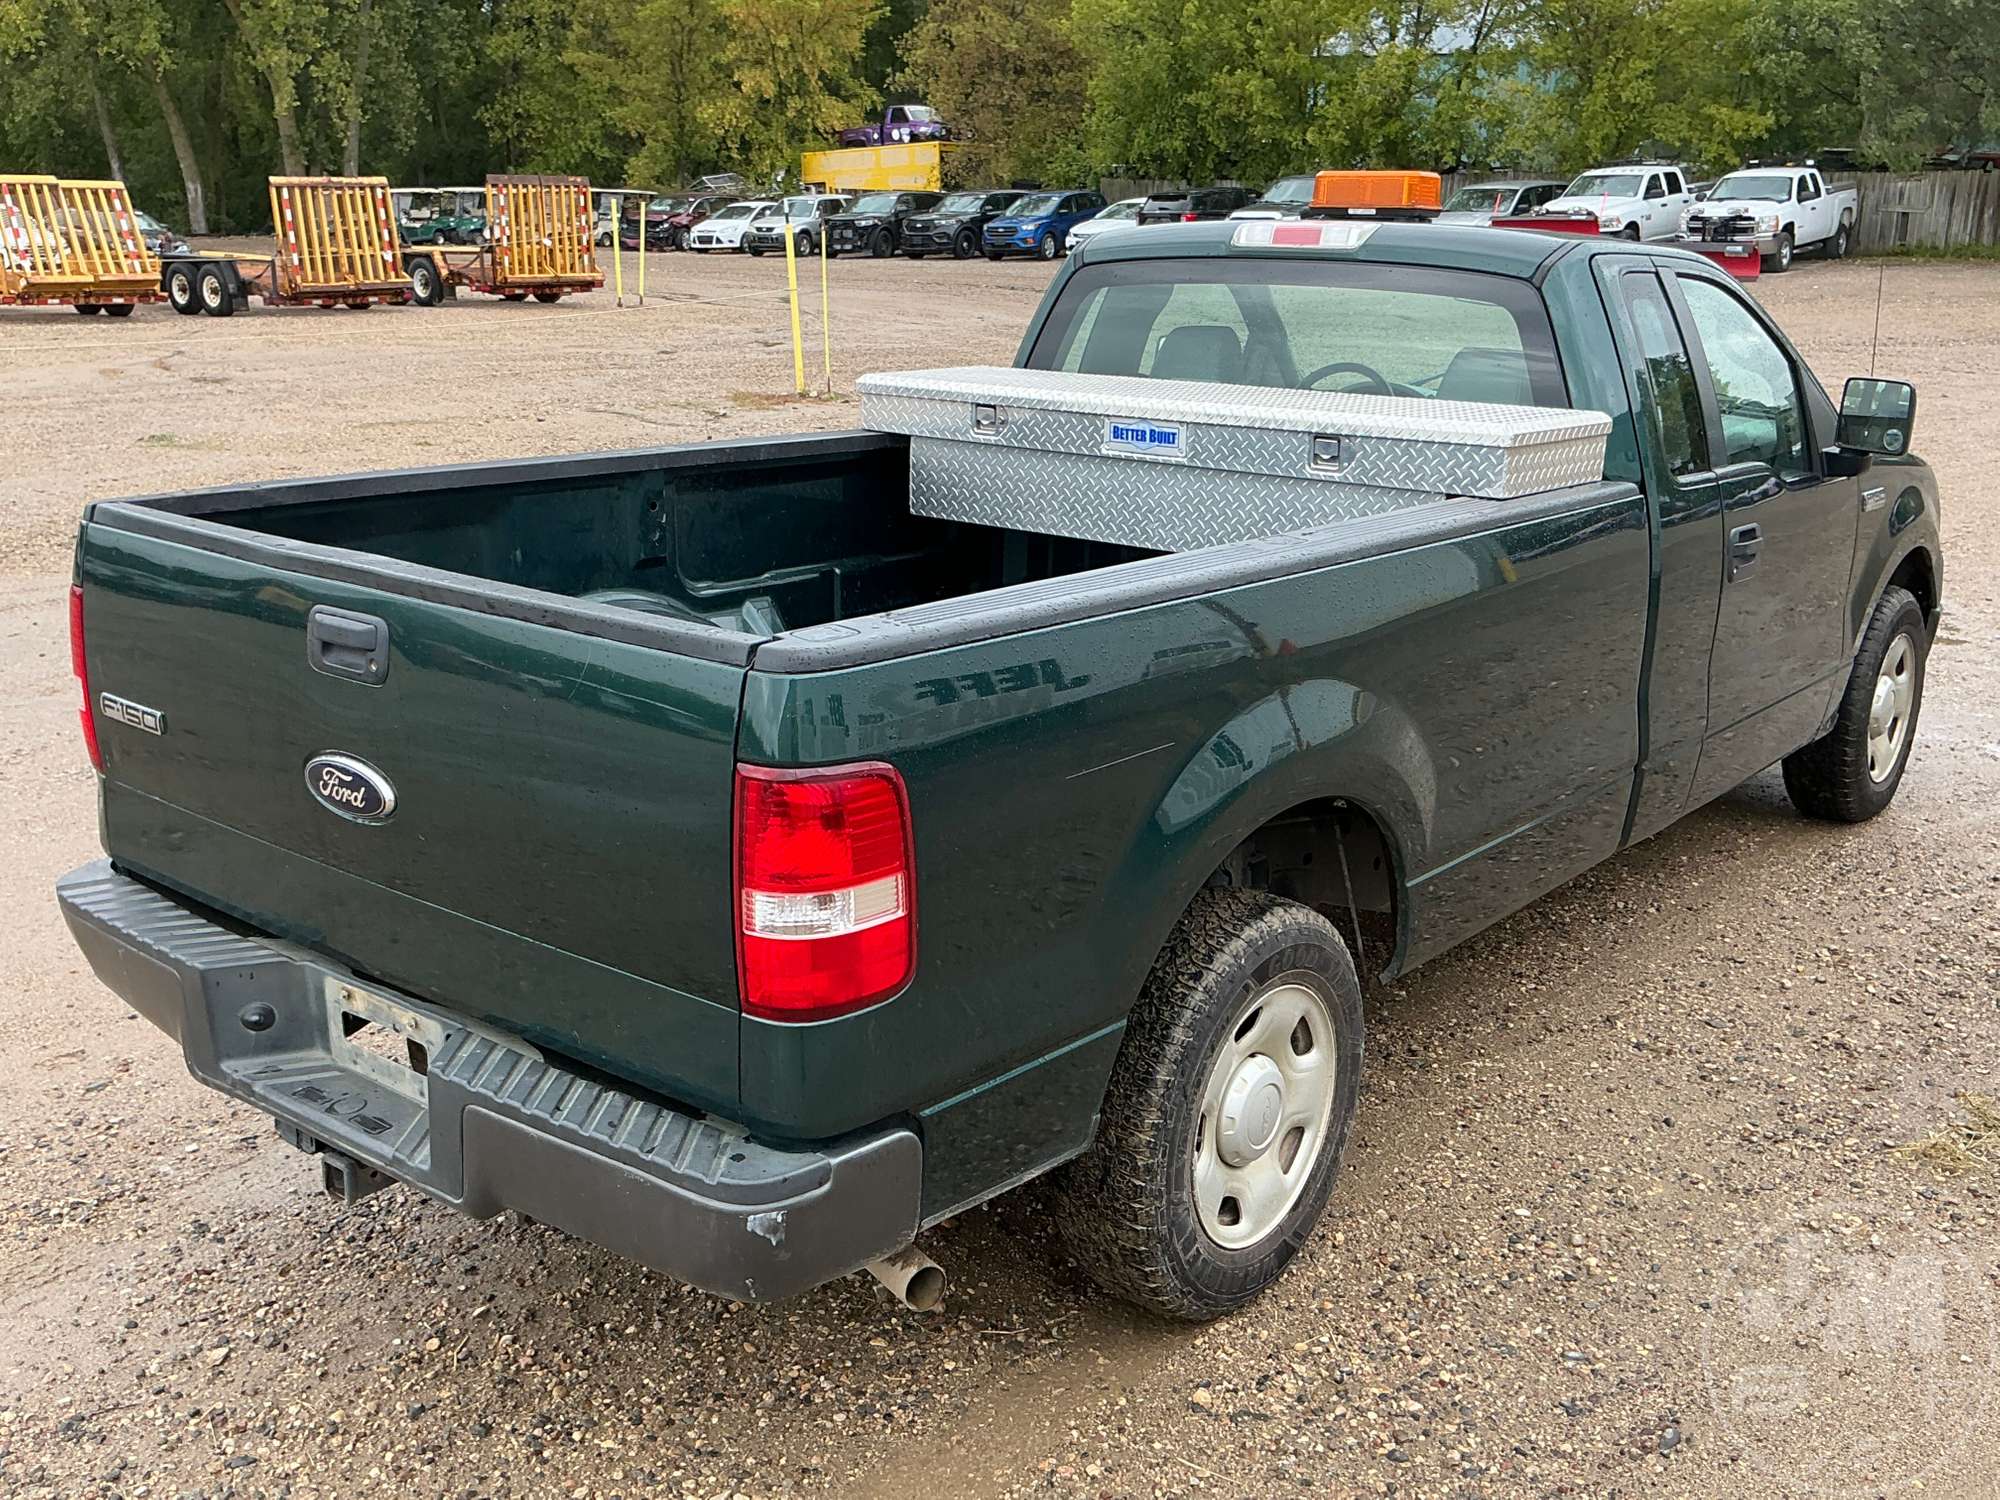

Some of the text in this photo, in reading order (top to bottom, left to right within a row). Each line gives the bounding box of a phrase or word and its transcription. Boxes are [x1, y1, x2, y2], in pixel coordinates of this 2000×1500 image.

[1112, 425, 1177, 444] BETTER BUILT
[319, 766, 366, 808] Ford
